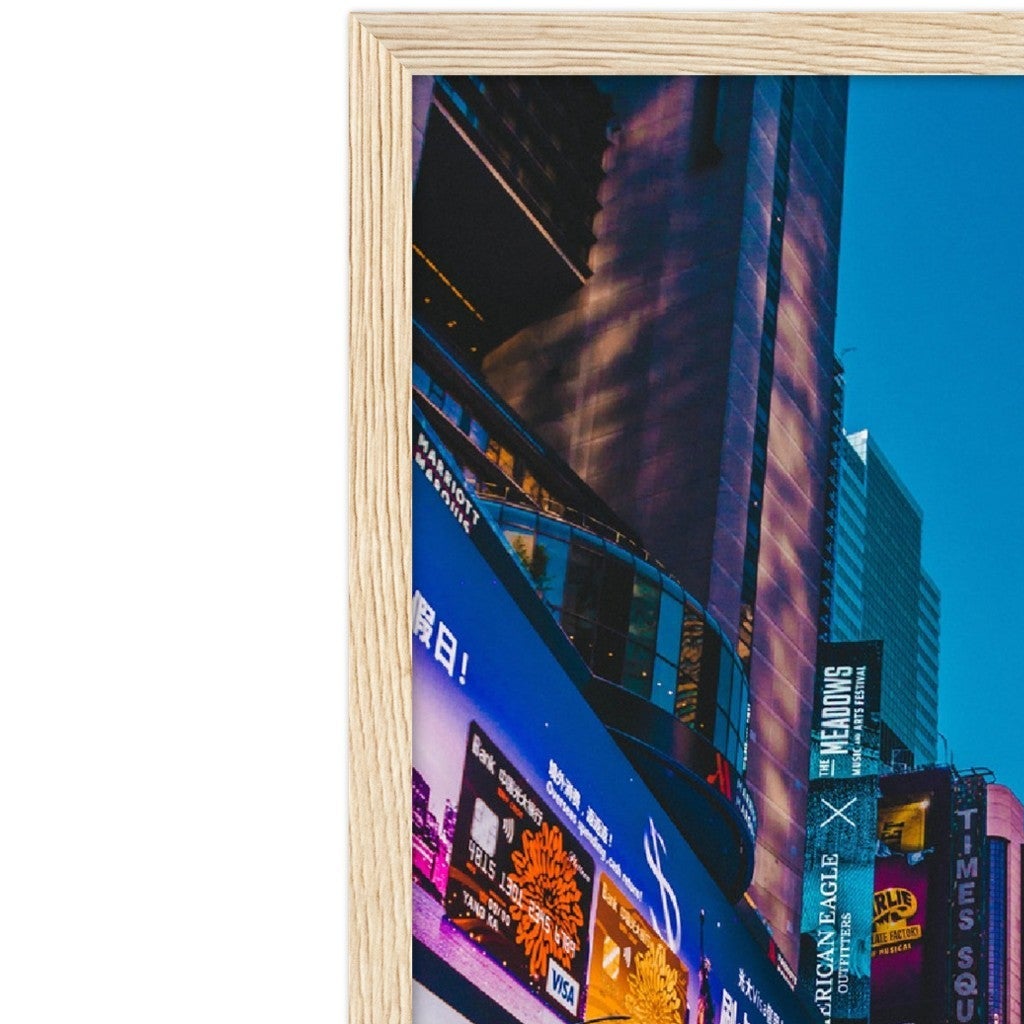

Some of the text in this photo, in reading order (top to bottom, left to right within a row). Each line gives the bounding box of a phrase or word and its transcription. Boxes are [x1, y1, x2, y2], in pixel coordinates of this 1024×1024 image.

[854, 665, 867, 705] FESTIVAL
[819, 666, 853, 777] THE MEADOWS
[853, 708, 865, 730] ARTS
[851, 747, 862, 776] MUSIC
[956, 808, 978, 931] TIMES
[819, 853, 839, 926] EAGLE
[837, 912, 852, 995] OUTFITTERS
[879, 943, 913, 955] MUSICAL
[889, 926, 919, 942] FACTORY
[552, 968, 575, 1006] VISA
